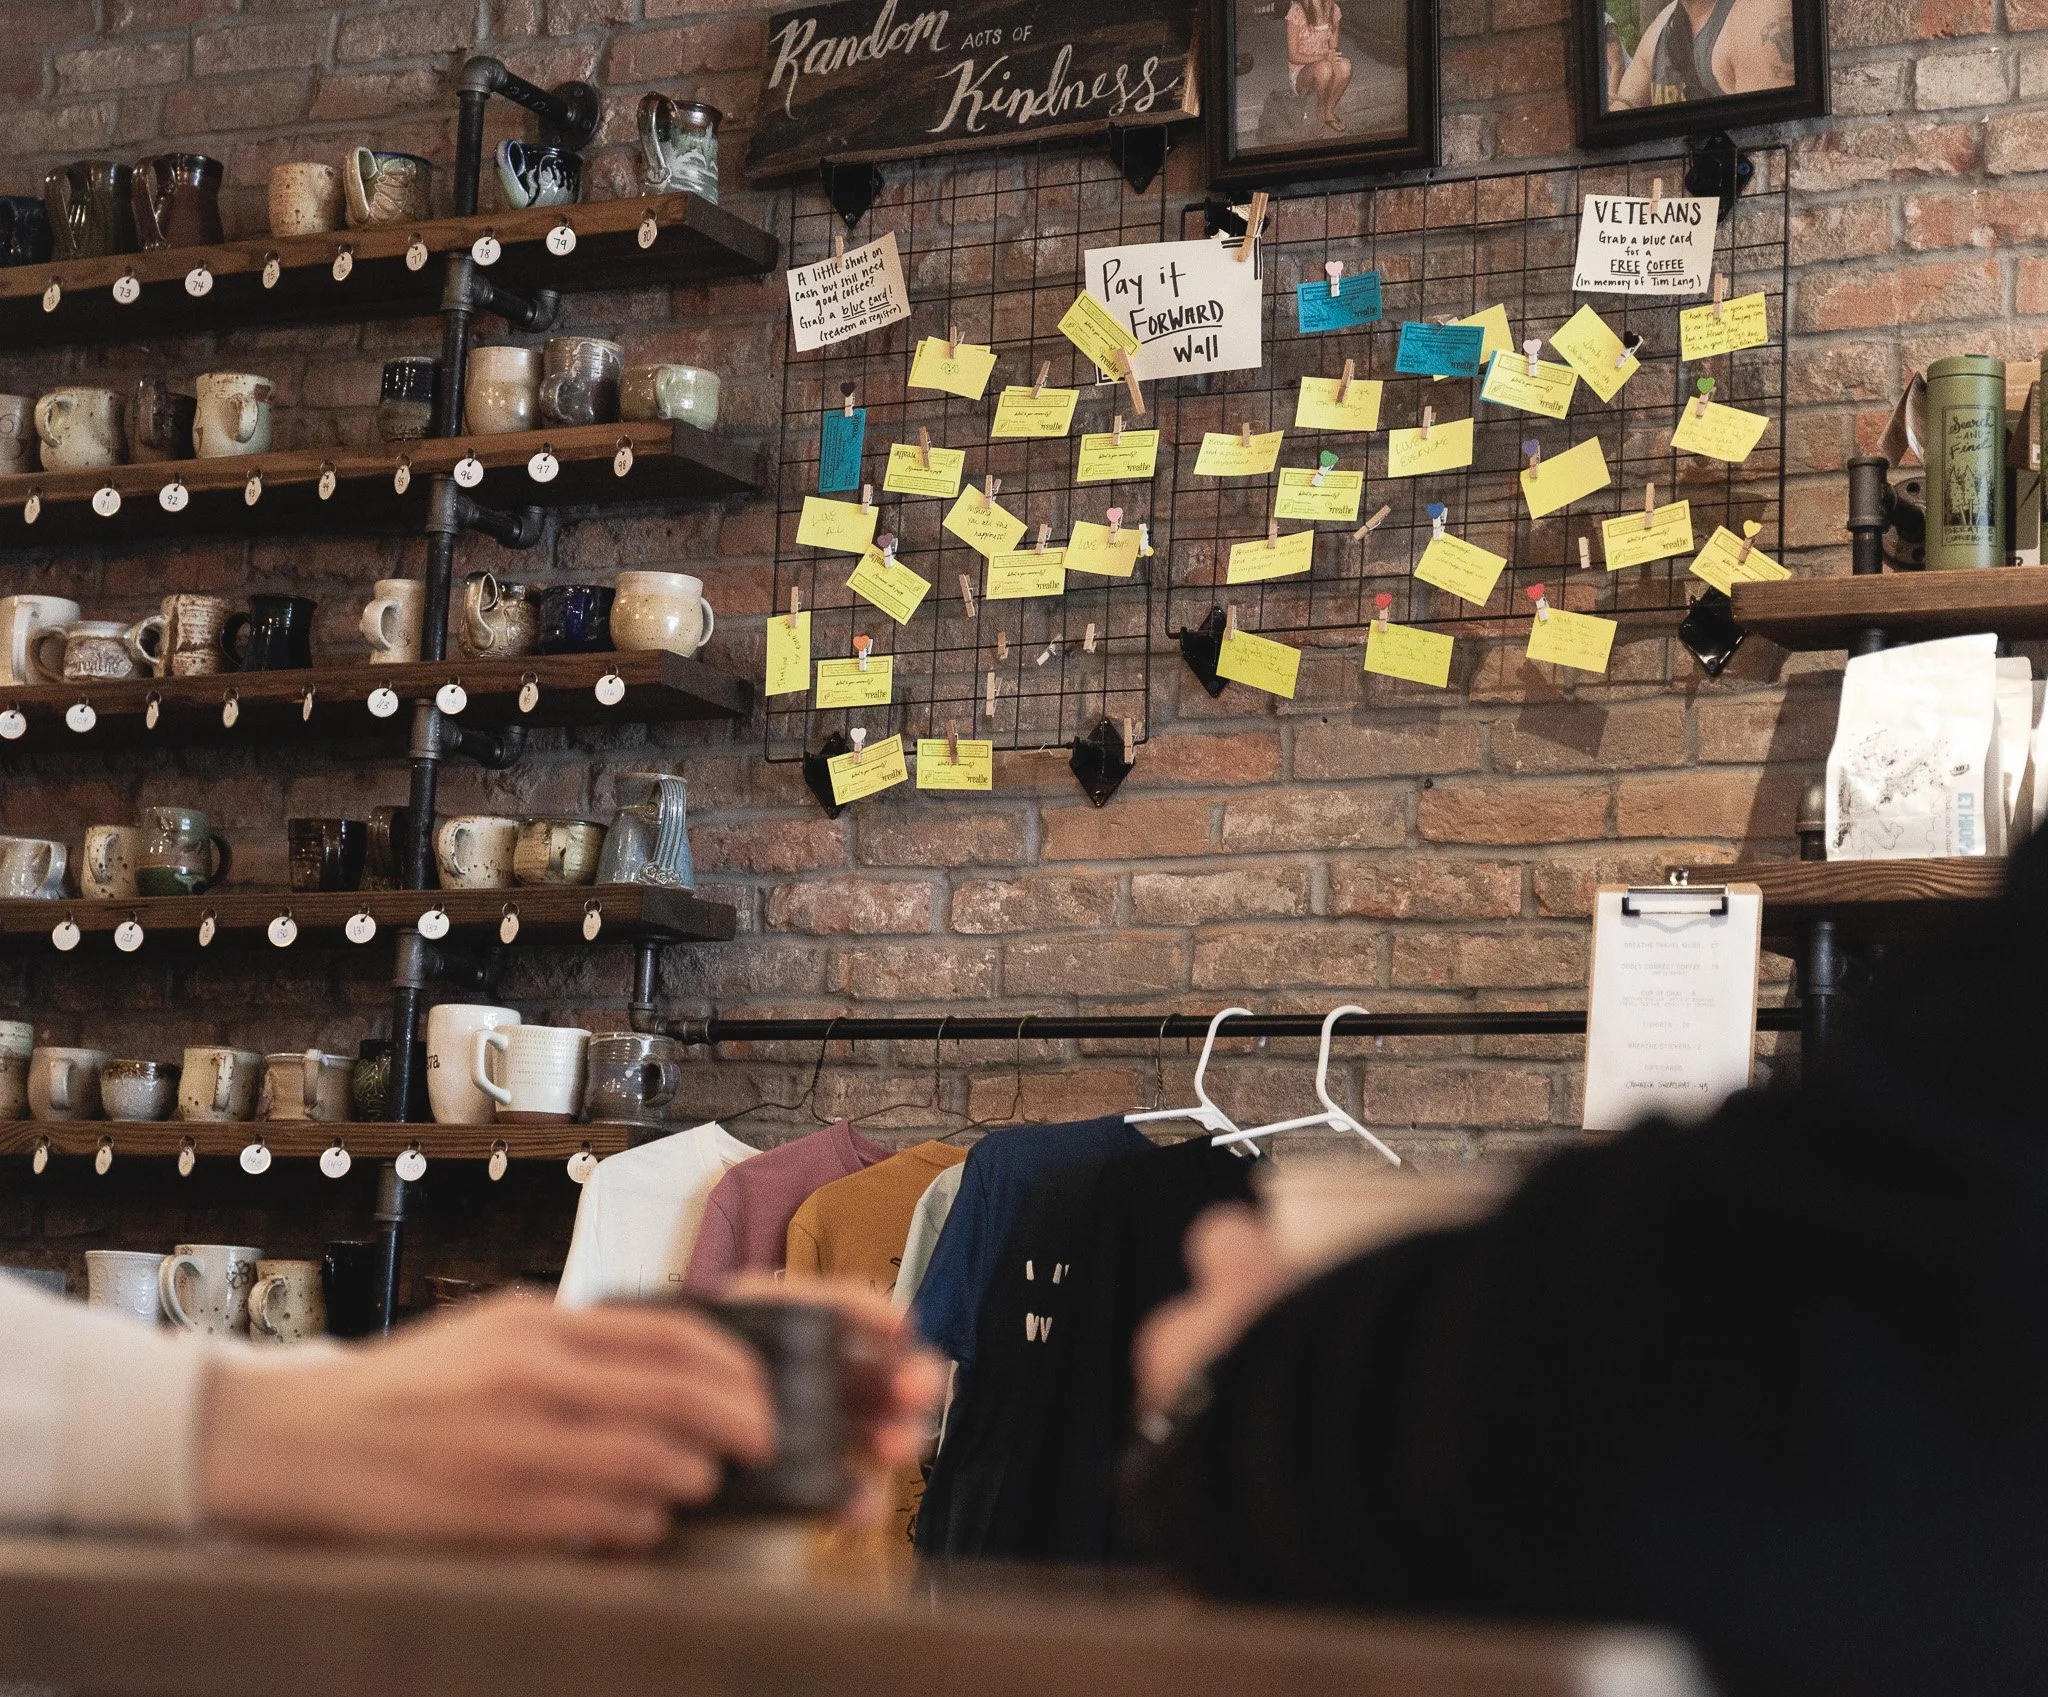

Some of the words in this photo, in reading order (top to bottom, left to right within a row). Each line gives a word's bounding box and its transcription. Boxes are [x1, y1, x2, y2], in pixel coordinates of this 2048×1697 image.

[961, 28, 1002, 50] ACTS
[1011, 25, 1033, 43] OF
[768, 0, 950, 120] Random
[926, 44, 1186, 134] Kindness
[553, 237, 568, 251] 79
[643, 229, 652, 243] 80
[1598, 230, 1627, 245] Grab
[1630, 236, 1637, 245] a
[1642, 231, 1667, 246] blue
[1669, 231, 1693, 247] card
[411, 251, 422, 265] 77
[479, 248, 491, 259] 78
[1624, 246, 1640, 257] for
[1645, 249, 1653, 257] a
[797, 272, 807, 287] A
[811, 261, 842, 284] little
[844, 252, 869, 276] short
[871, 247, 883, 258] on
[1610, 259, 1641, 272] FREE
[1646, 258, 1685, 272] COFFEE
[266, 269, 277, 283] 75
[822, 280, 838, 295] but
[840, 273, 859, 289] still
[861, 259, 885, 281] need
[1102, 257, 1143, 305] Pay
[1159, 260, 1186, 298] it
[1575, 272, 1591, 289] (In
[1593, 278, 1631, 290] memory
[1634, 276, 1646, 287] of
[1651, 276, 1670, 287] Tim
[1671, 274, 1702, 290] Lang)
[119, 286, 132, 298] 73
[192, 280, 205, 292] 74
[815, 290, 839, 316] good
[841, 277, 876, 301] coffee?
[799, 312, 826, 330] Grab
[829, 311, 837, 320] a
[841, 299, 866, 318] blue
[867, 284, 894, 308] card!
[819, 322, 857, 343] (redeem
[858, 316, 868, 329] at
[868, 303, 903, 326] register)
[1129, 299, 1224, 340] FORWARD
[1172, 334, 1219, 363] Wall
[1947, 412, 1995, 435] Search
[1950, 439, 1993, 460] Find
[536, 464, 551, 474] 97
[618, 459, 628, 471] 98
[460, 470, 472, 481] 96
[167, 494, 178, 506] 92
[376, 699, 391, 710] 113
